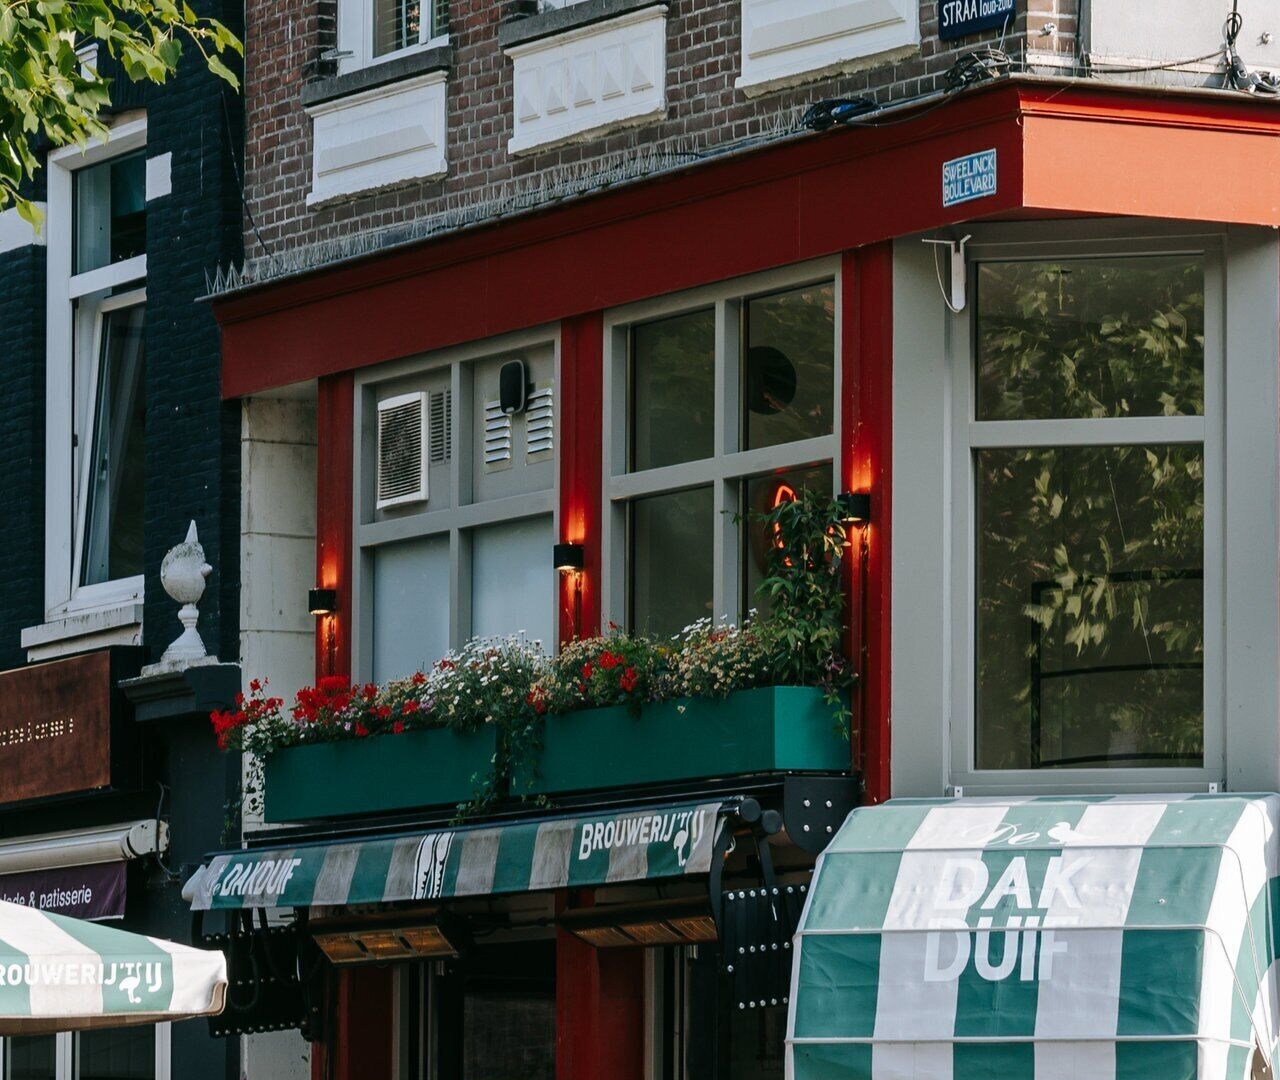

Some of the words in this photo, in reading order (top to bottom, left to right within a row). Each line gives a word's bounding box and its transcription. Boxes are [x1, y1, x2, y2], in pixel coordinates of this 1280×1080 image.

[943, 152, 995, 183] SWEELINCK
[943, 173, 995, 200] BOULEVARD
[578, 813, 676, 861] BROUWERIJ
[219, 858, 302, 896] DAKDUIF
[933, 855, 1095, 910] DAK
[39, 884, 92, 910] patisserie
[923, 915, 1080, 983] DUIF
